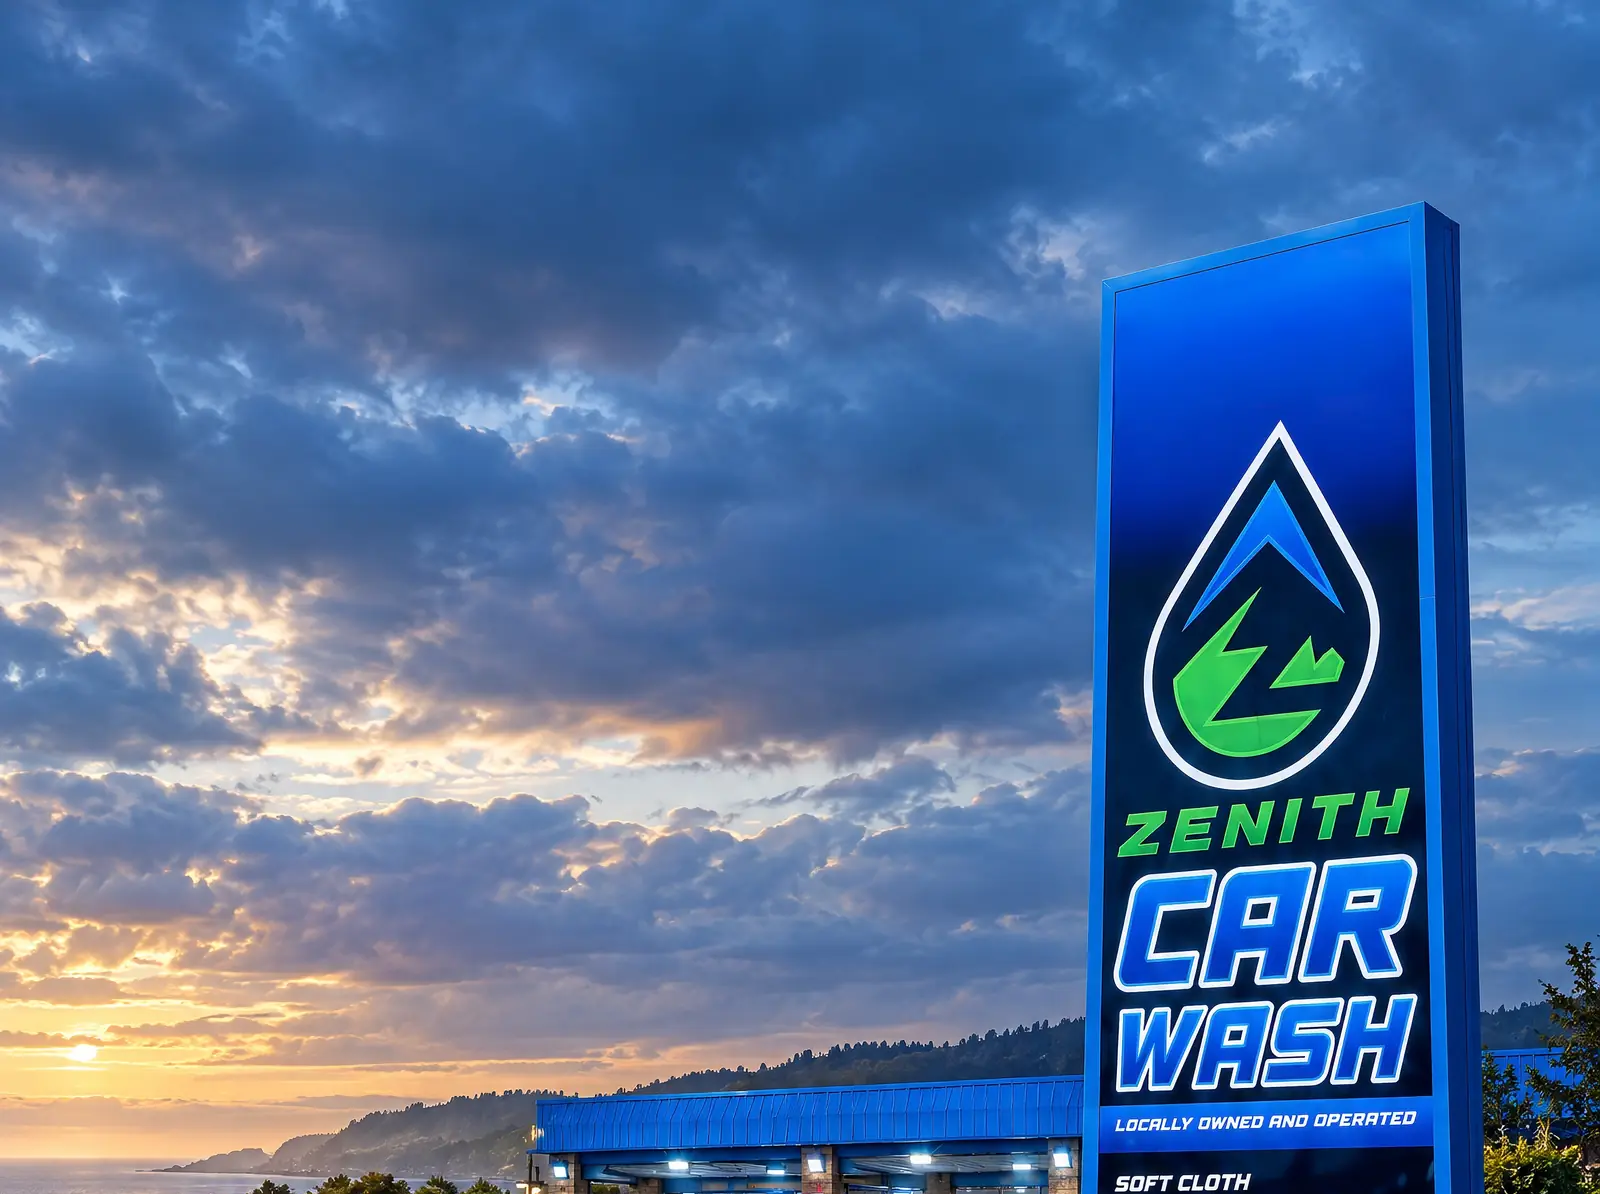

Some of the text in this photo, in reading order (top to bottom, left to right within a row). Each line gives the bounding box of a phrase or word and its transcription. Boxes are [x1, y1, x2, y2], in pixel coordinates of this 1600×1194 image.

[1118, 788, 1410, 857] ZENITH
[1114, 854, 1417, 992] CAR
[1115, 994, 1418, 1092] WASH
[1115, 1111, 1416, 1131] LOCALLY OWNED AND OPERATED
[1115, 1174, 1251, 1192] SOFT CLOTH
